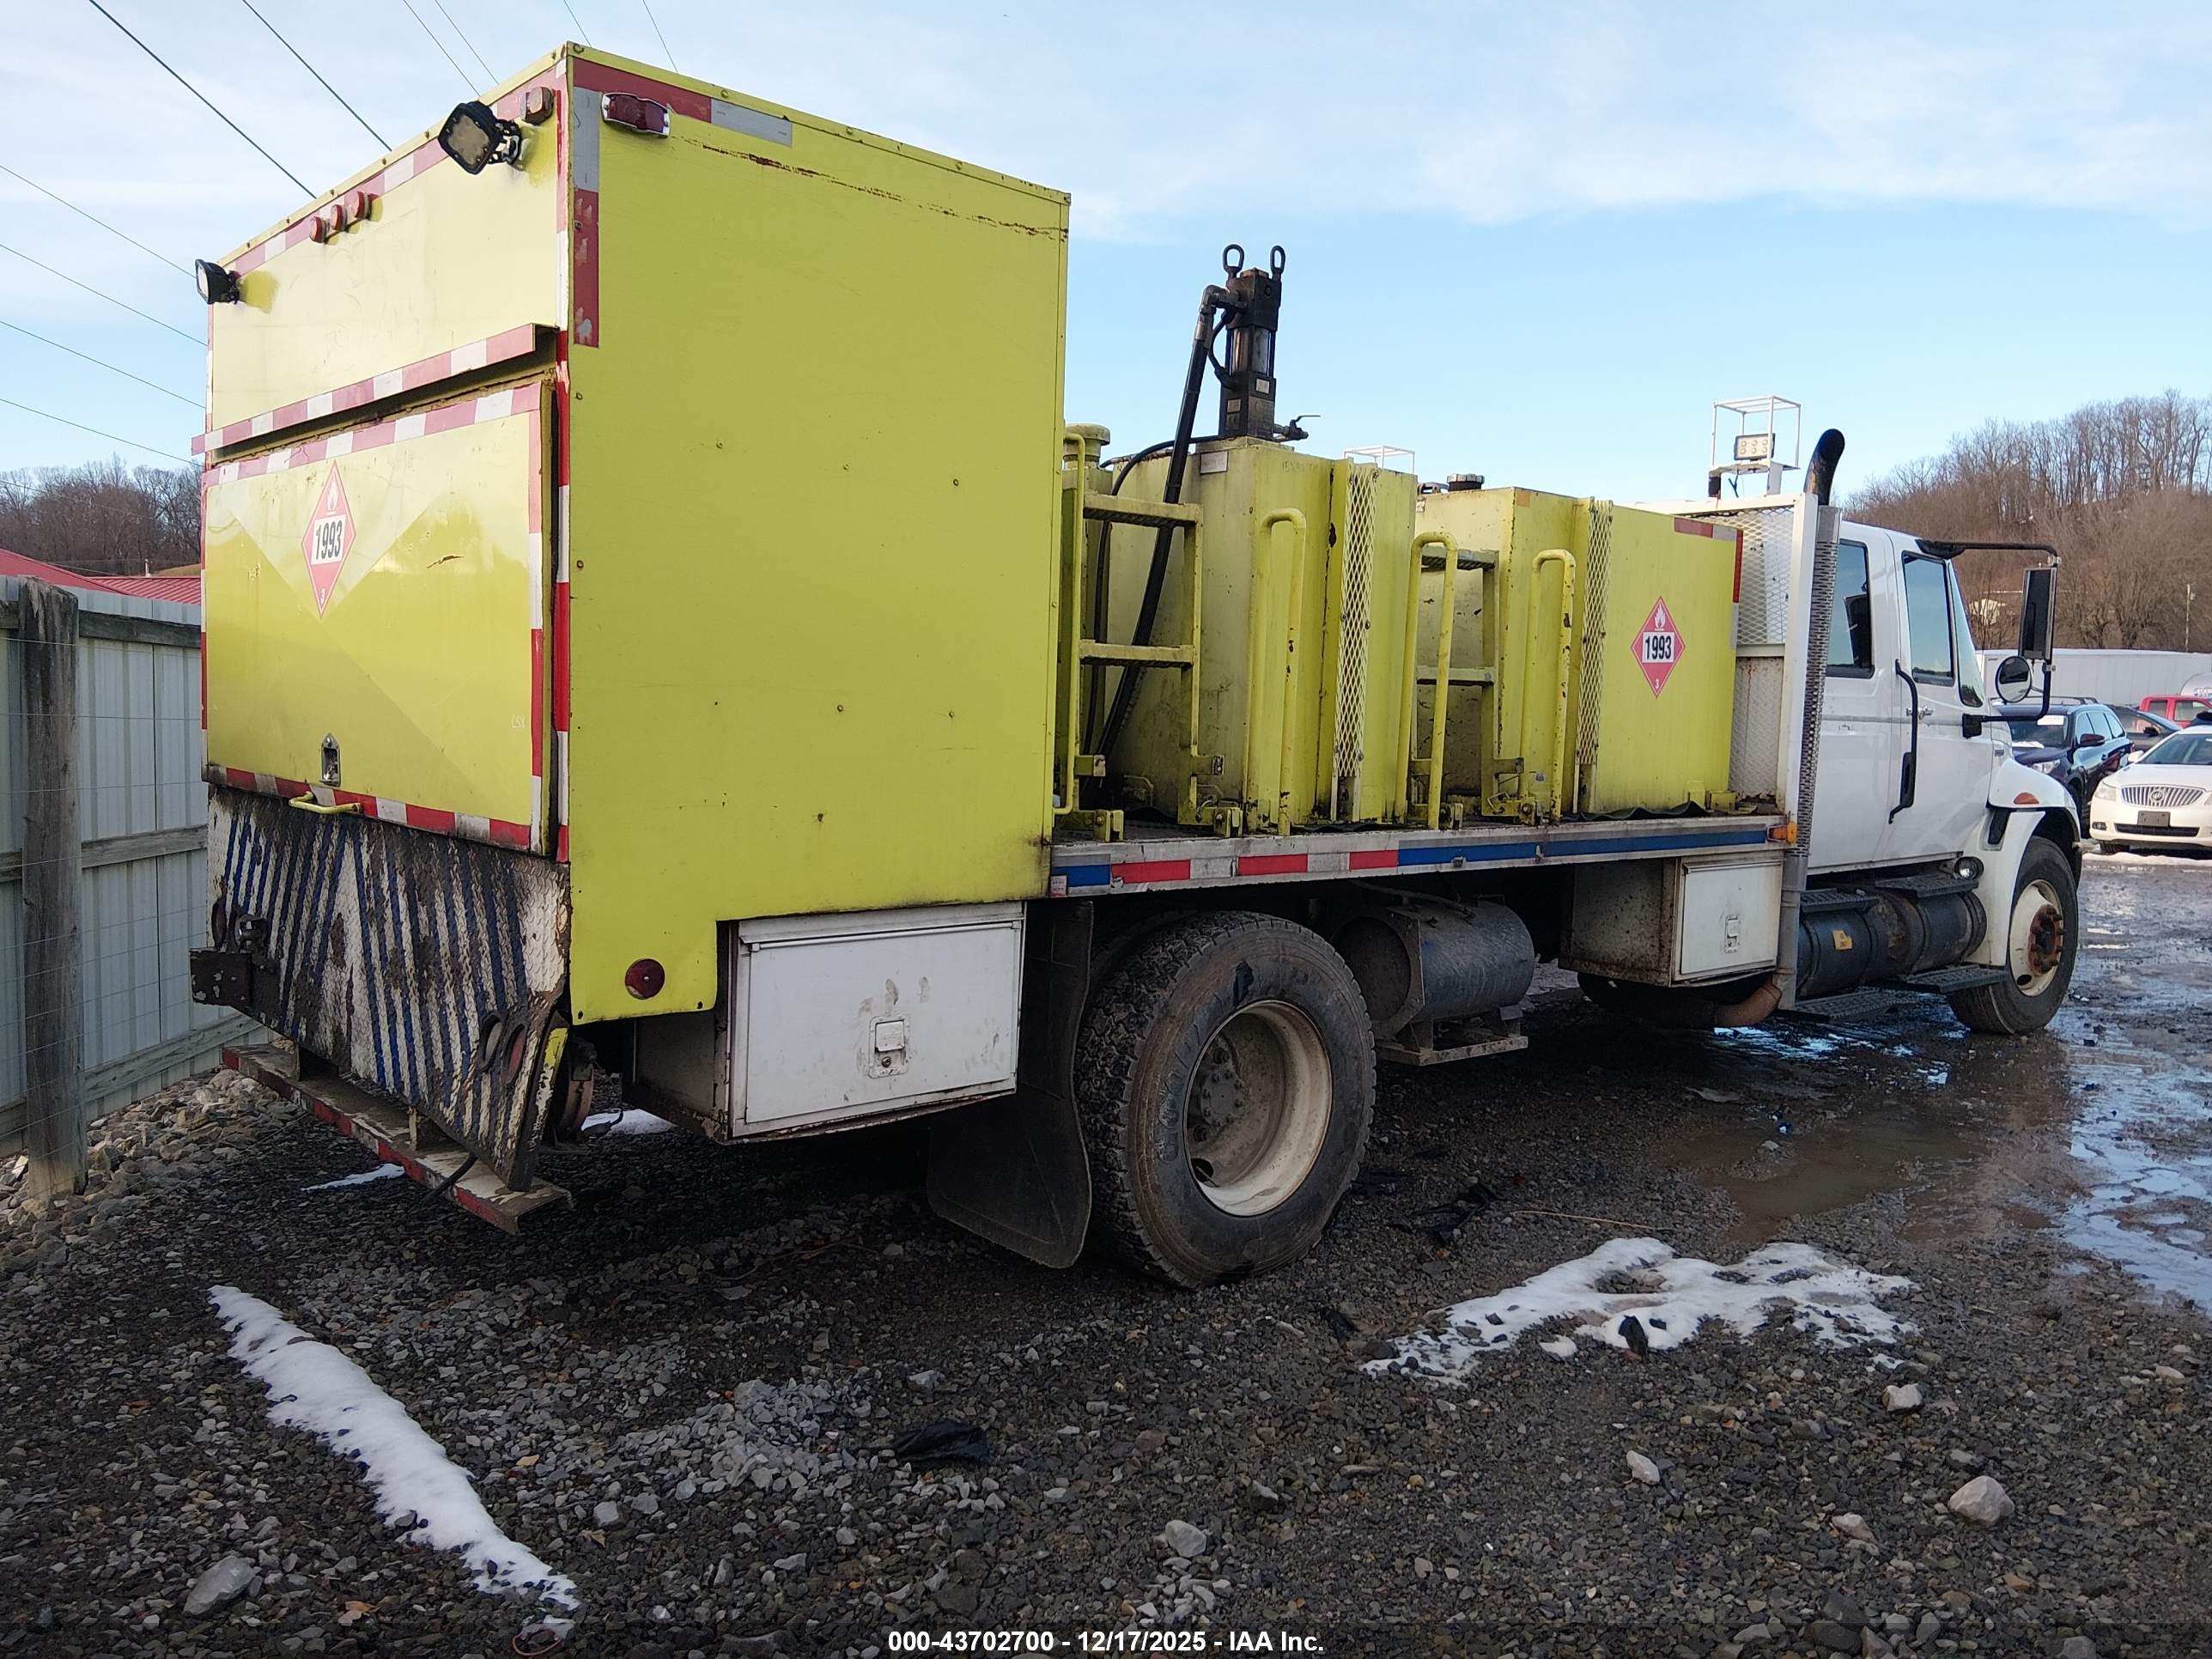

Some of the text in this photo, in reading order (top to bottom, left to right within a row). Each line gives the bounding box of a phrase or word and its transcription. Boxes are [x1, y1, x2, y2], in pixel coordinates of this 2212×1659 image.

[315, 520, 343, 560] 1993
[320, 587, 325, 604] 3
[1645, 635, 1672, 660] 1993
[1655, 678, 1660, 690] 3
